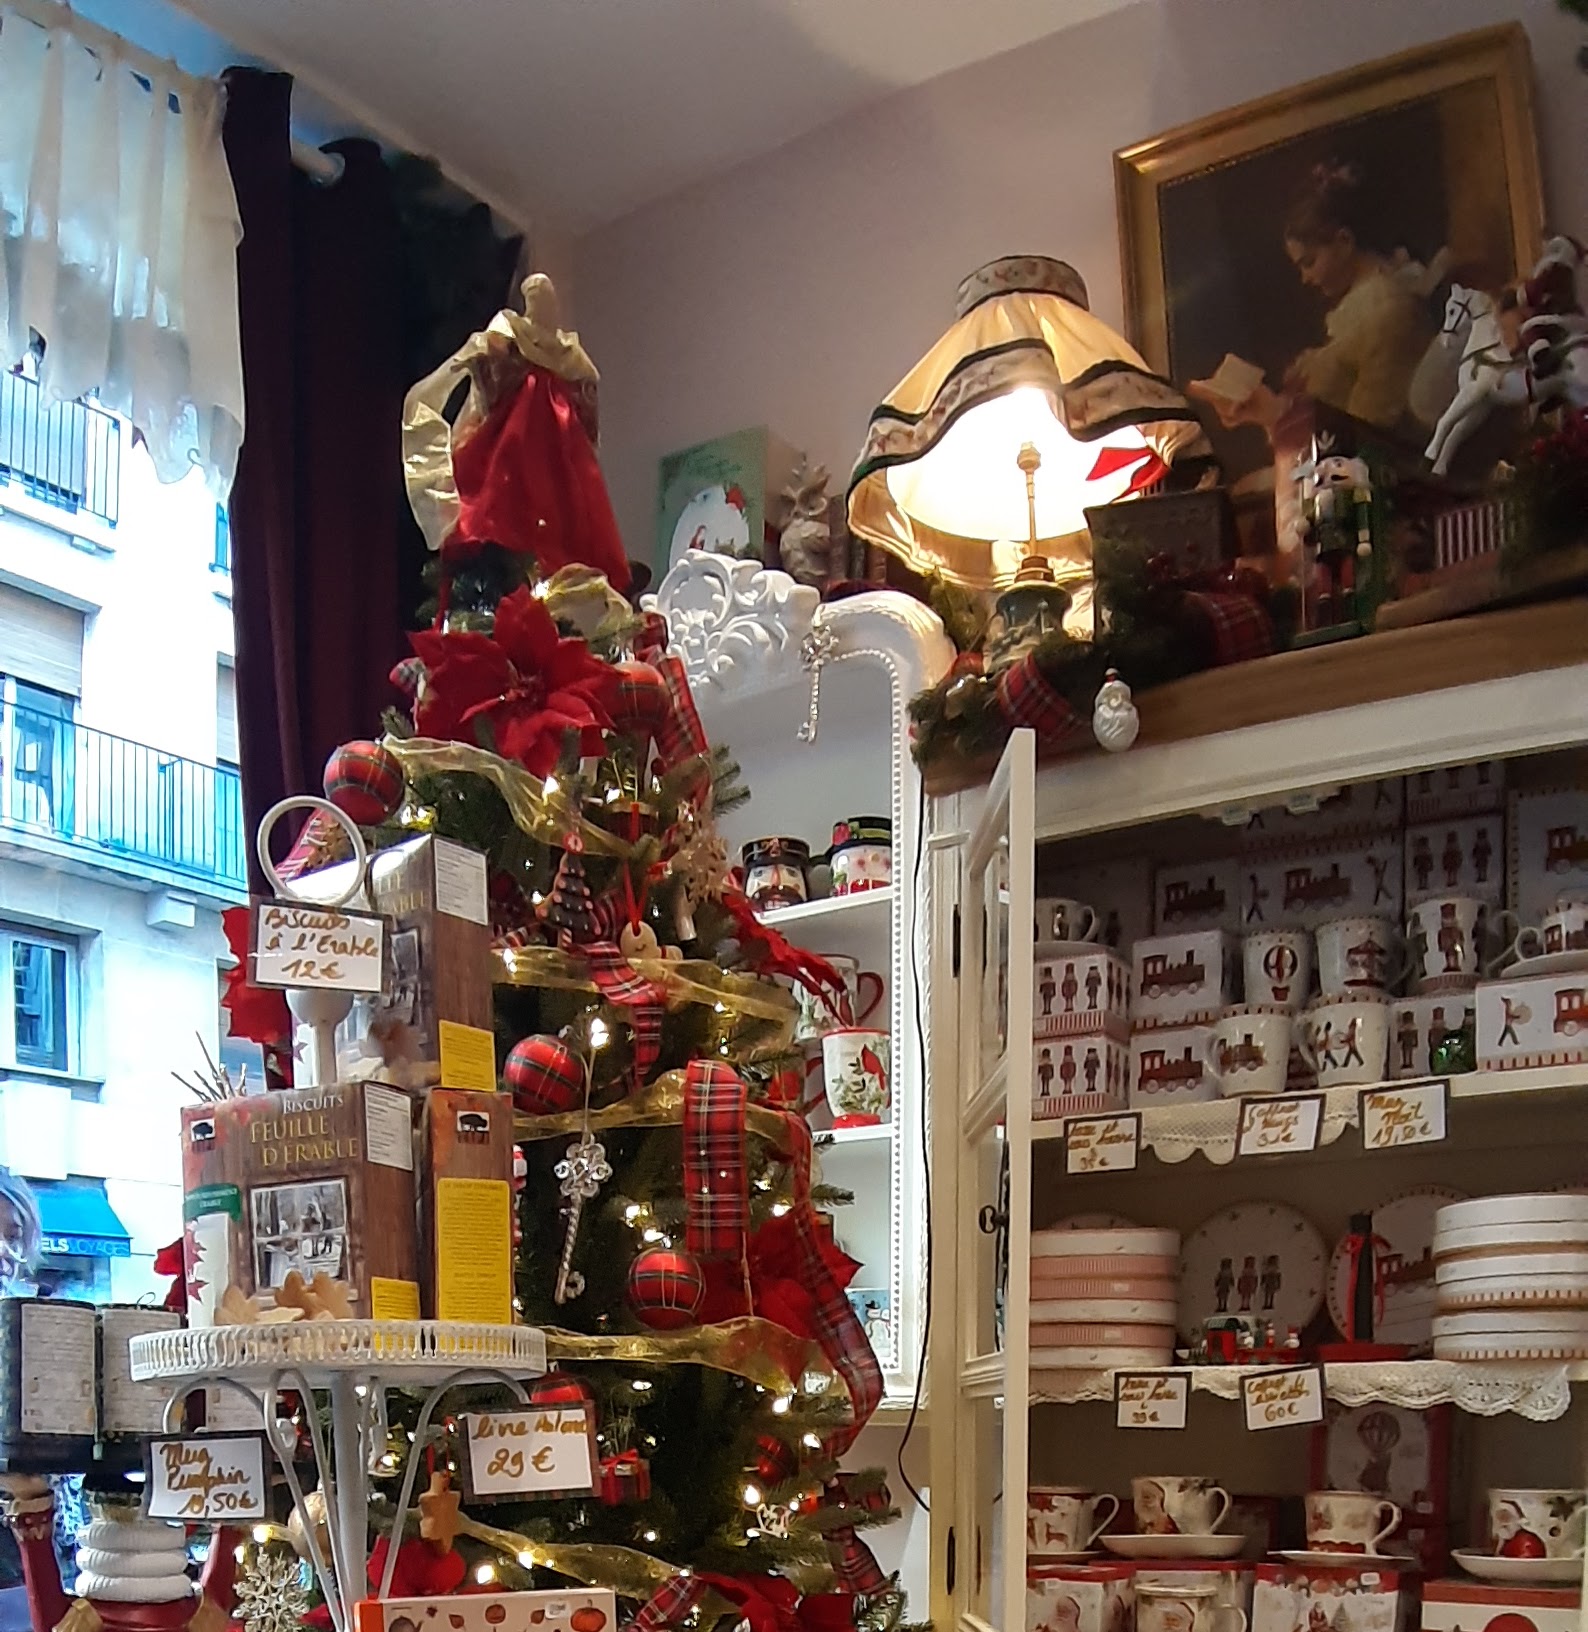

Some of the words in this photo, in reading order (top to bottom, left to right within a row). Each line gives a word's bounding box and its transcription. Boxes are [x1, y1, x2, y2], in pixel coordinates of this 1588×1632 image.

[281, 958, 345, 980] 12€
[282, 1094, 344, 1115] BISCUITS
[250, 1114, 329, 1143] FEUILLE
